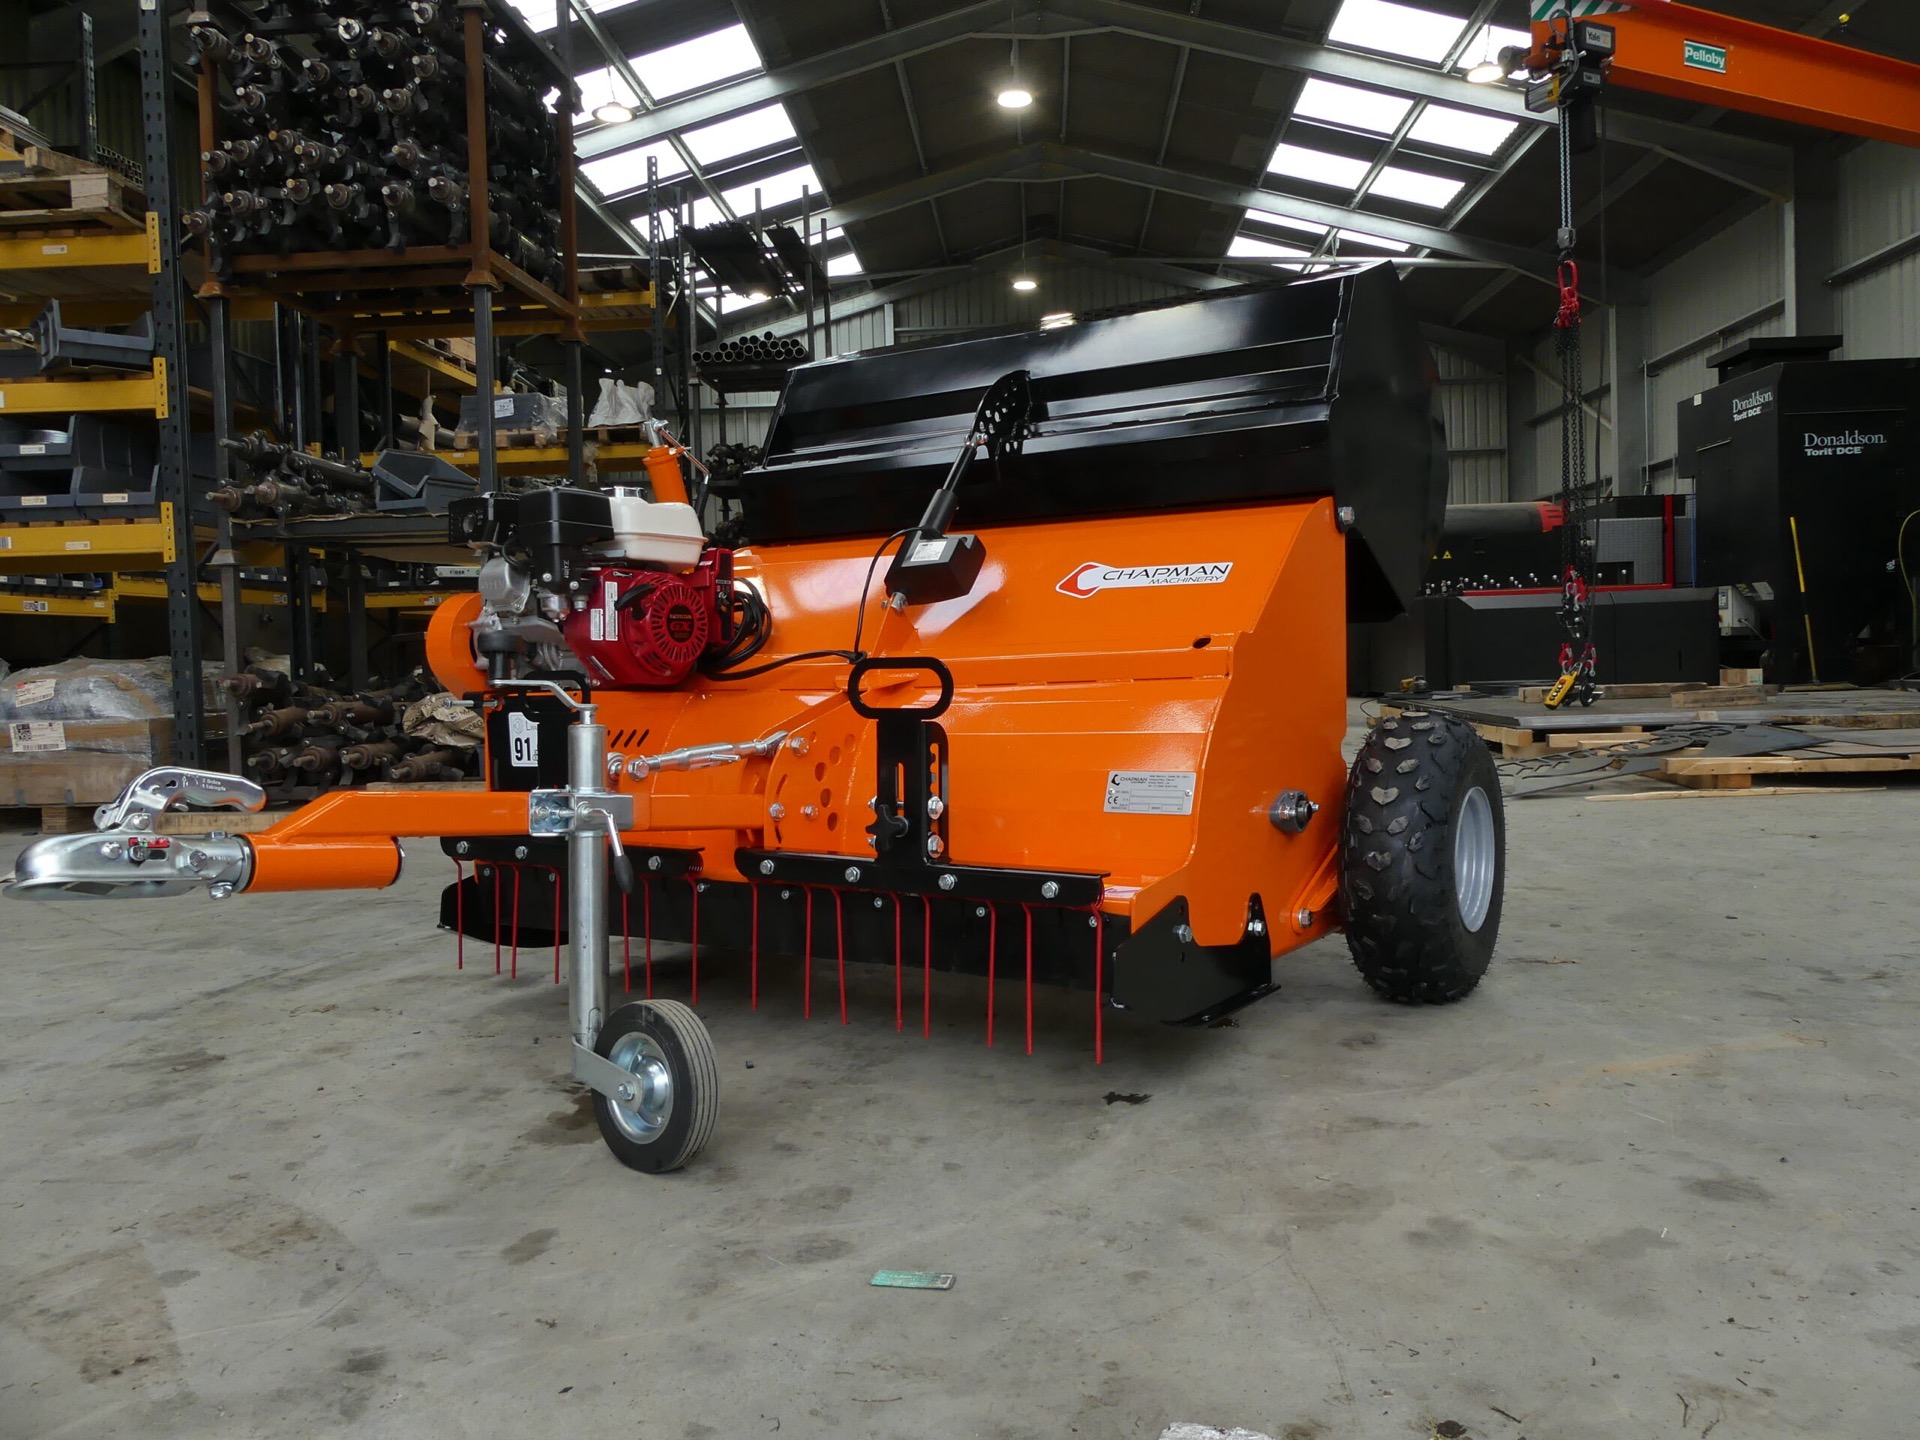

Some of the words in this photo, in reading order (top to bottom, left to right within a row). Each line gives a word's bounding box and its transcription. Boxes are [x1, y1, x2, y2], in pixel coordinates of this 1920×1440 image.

[1587, 30, 1601, 42] Yale
[1685, 46, 1726, 69] Pelloby
[1103, 564, 1231, 581] CHAPMAN
[1148, 575, 1224, 585] MACHINERY
[514, 737, 531, 762] 91
